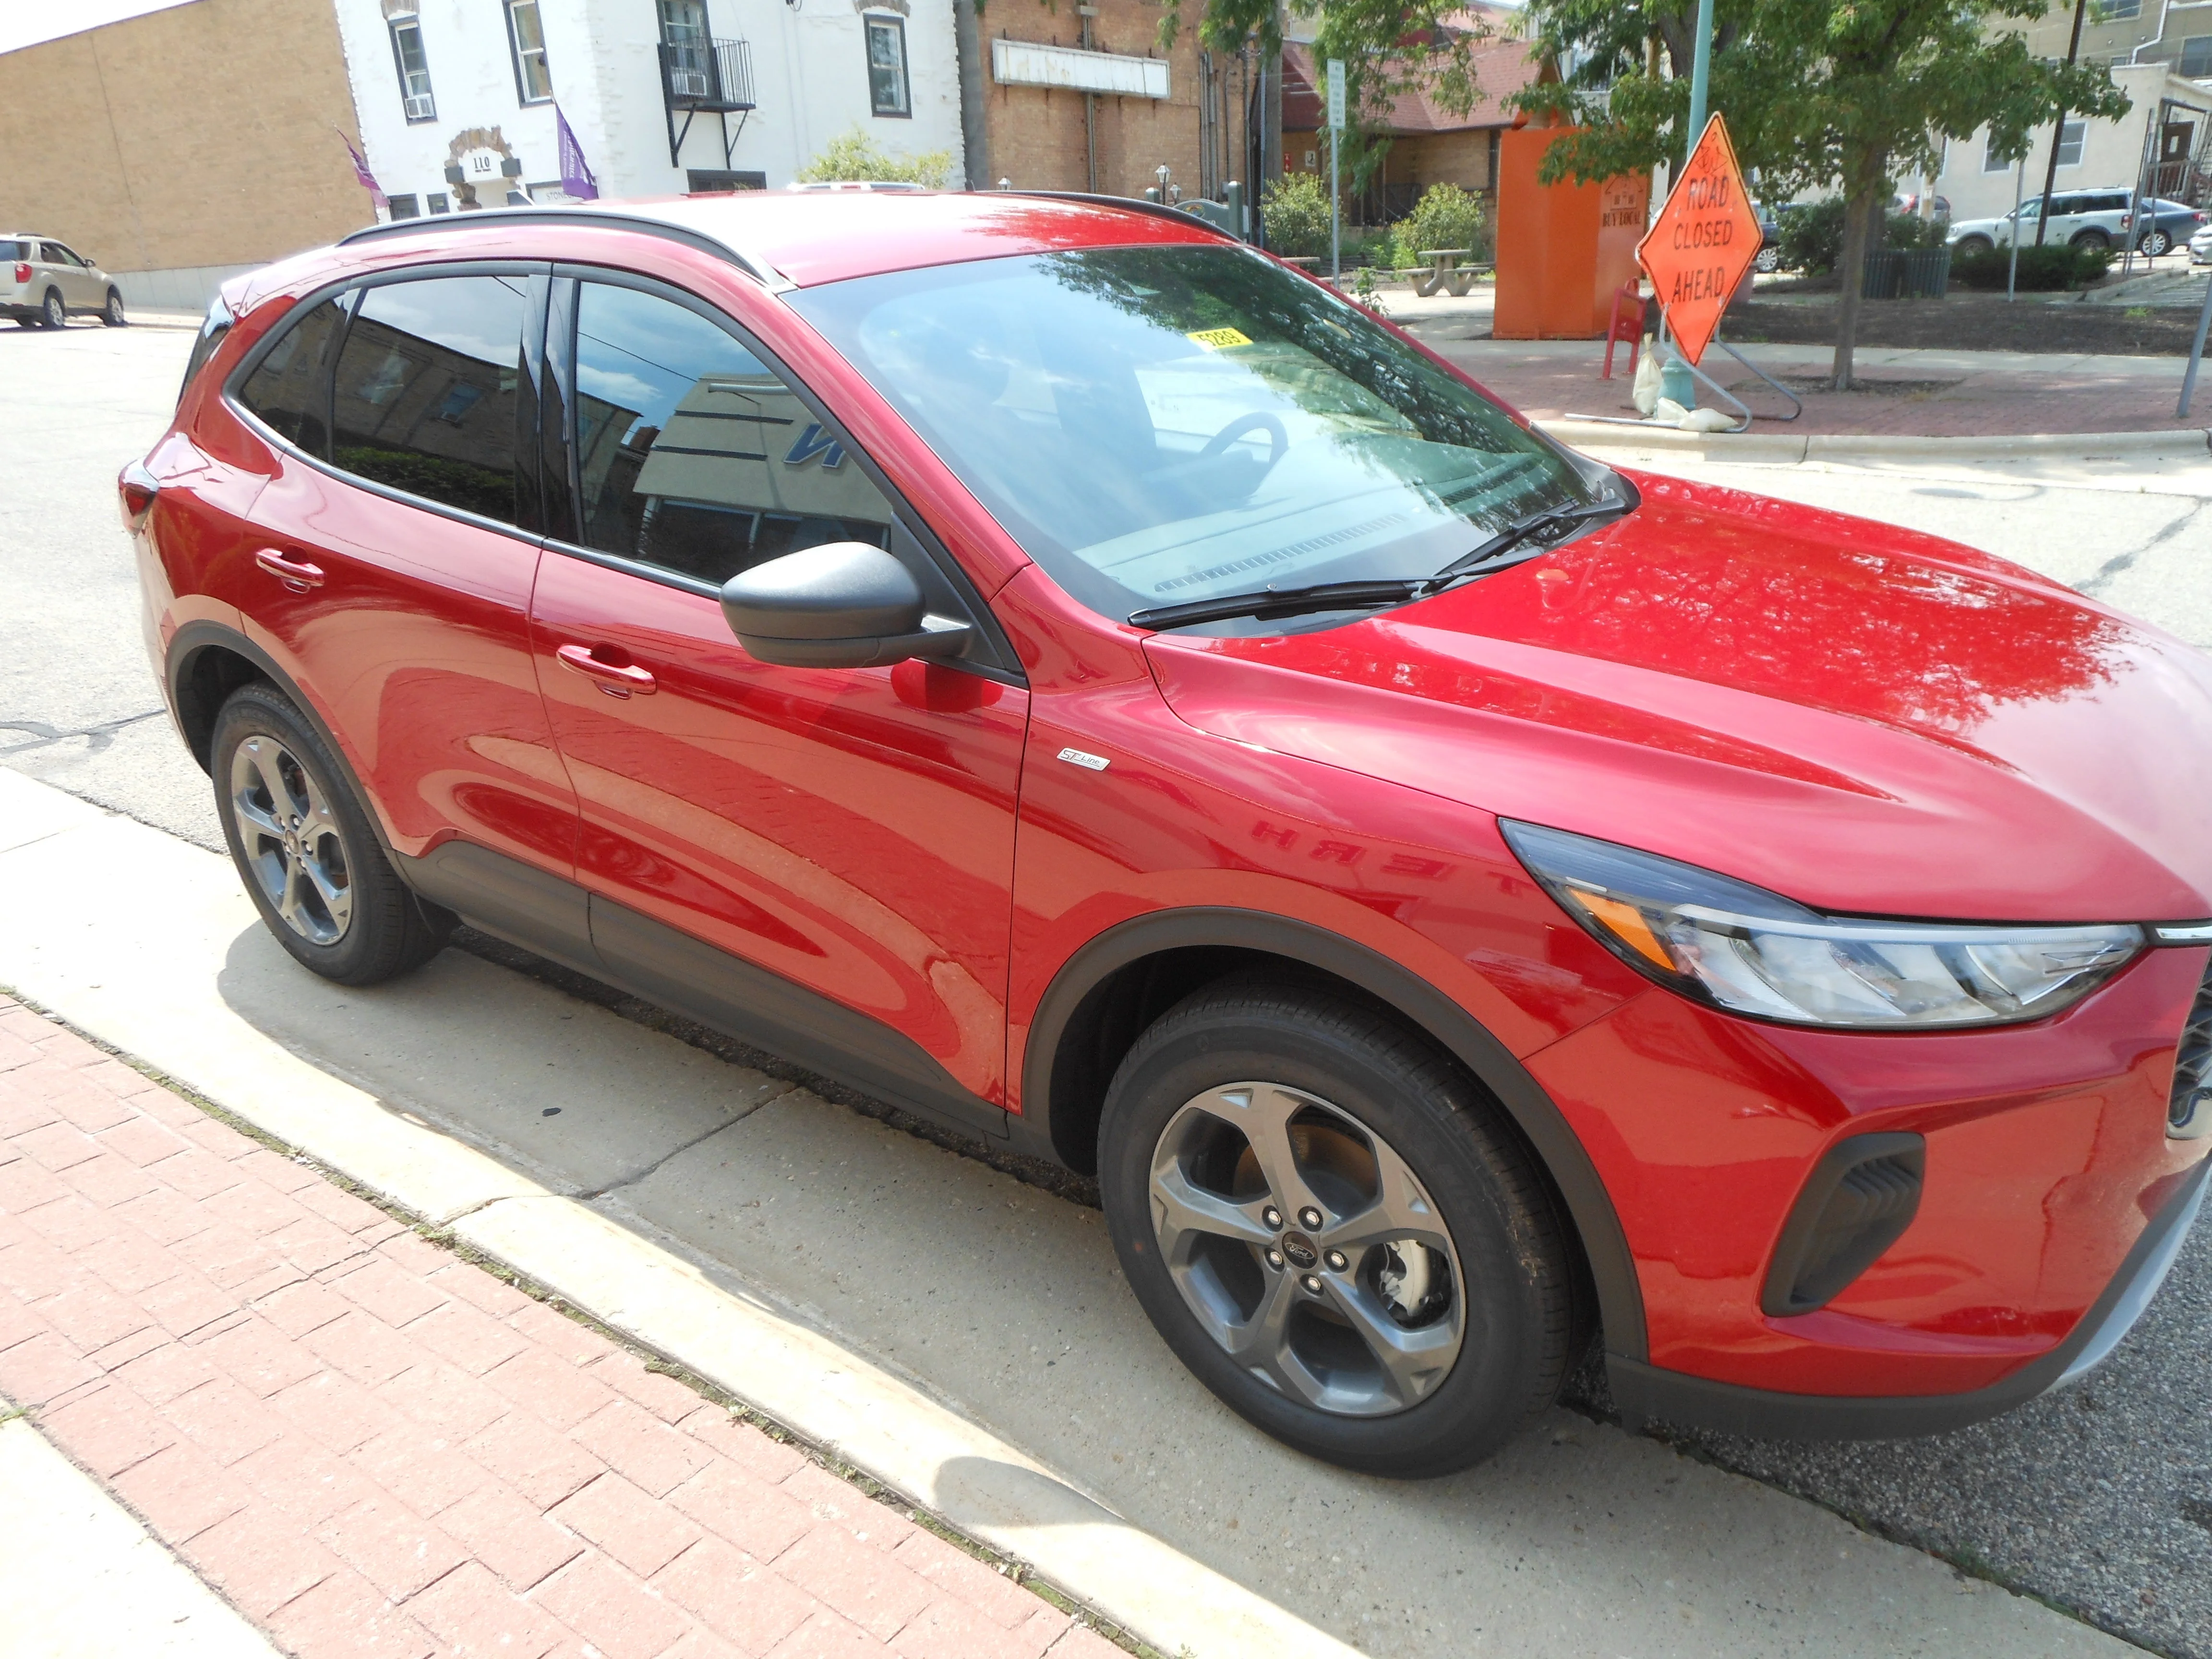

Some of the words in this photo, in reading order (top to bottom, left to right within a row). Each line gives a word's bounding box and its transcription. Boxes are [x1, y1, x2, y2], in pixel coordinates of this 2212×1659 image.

[473, 156, 490, 168] 110
[1687, 176, 1729, 211] ROAD
[1673, 219, 1732, 250] CLOSED
[1672, 266, 1725, 304] AHEAD
[1060, 750, 1080, 760] ST
[1081, 755, 1100, 765] Line
[1289, 1245, 1308, 1257] Ford
